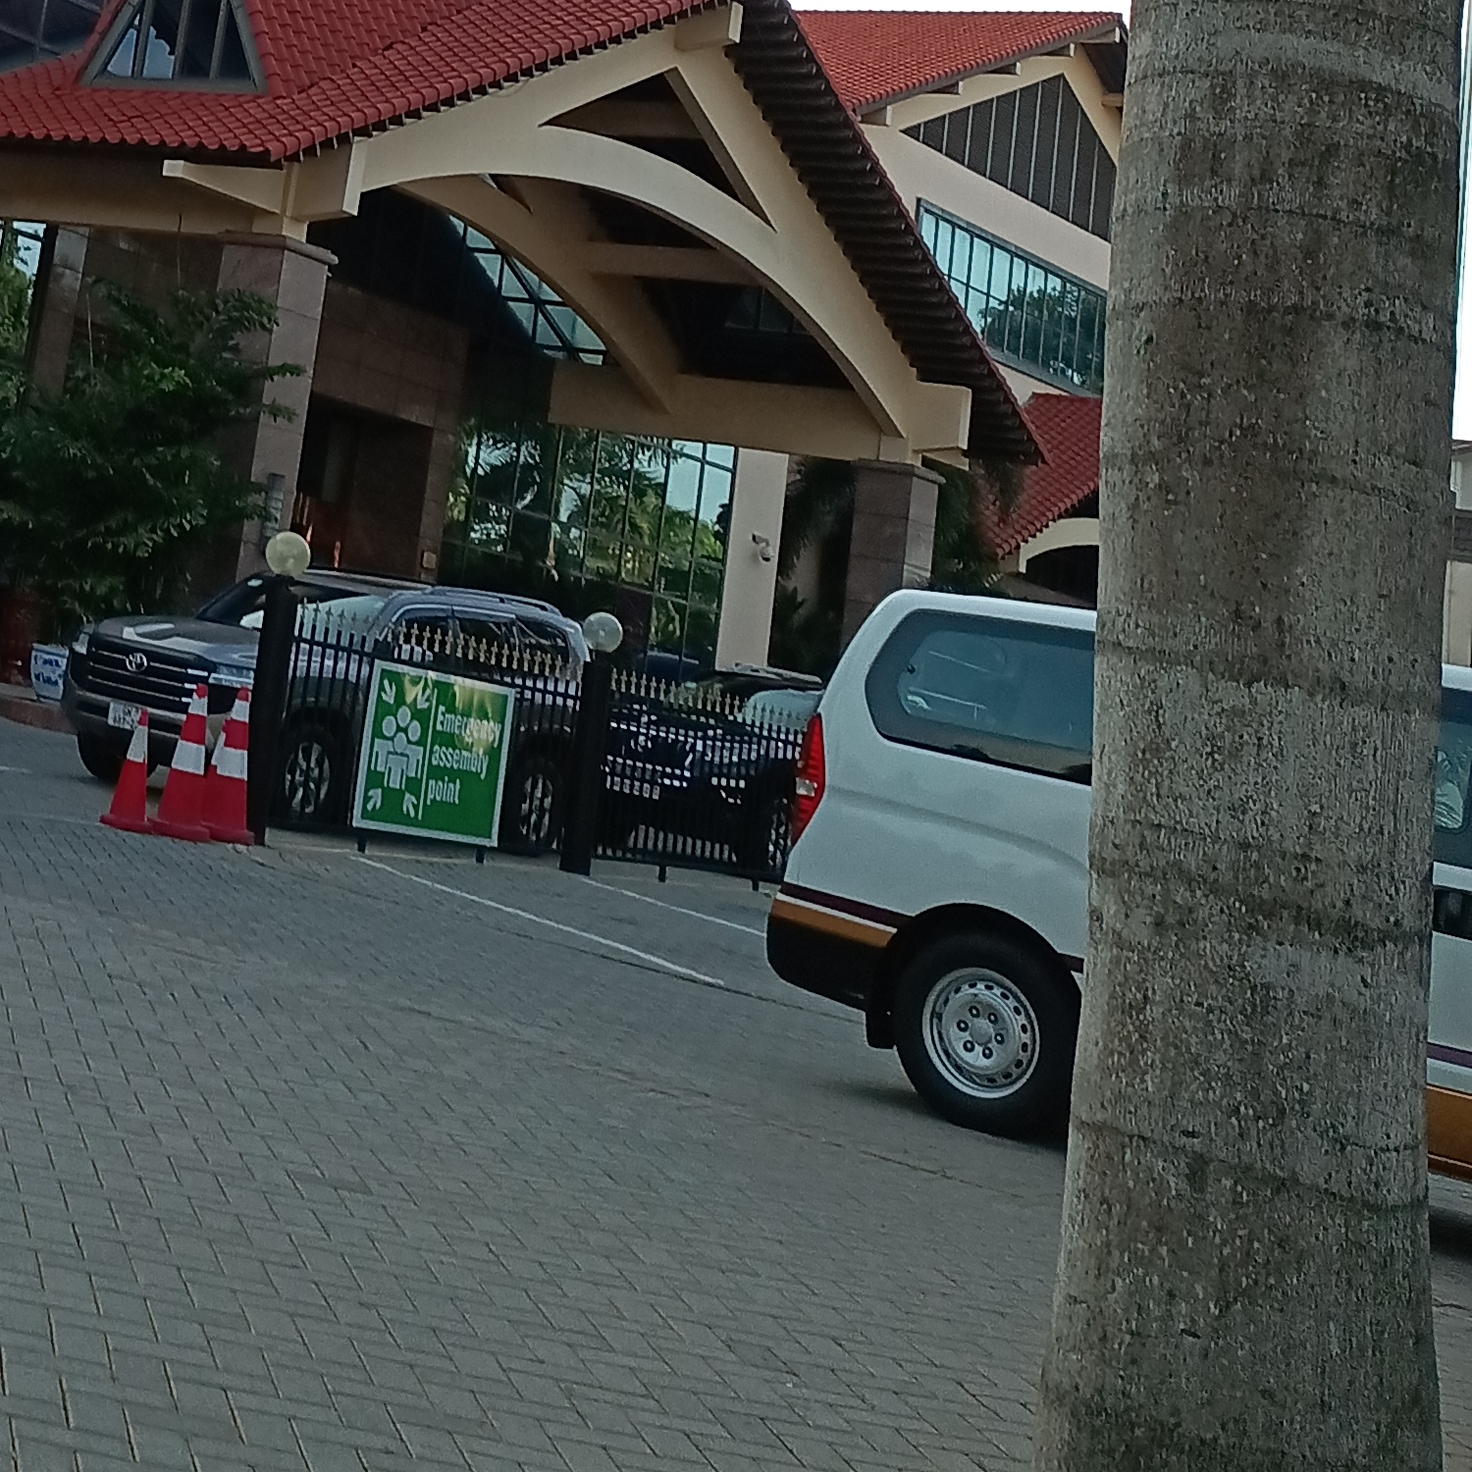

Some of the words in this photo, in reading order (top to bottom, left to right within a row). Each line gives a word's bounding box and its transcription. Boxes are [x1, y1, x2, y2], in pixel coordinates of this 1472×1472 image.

[436, 705, 501, 748] Emergency
[432, 744, 488, 780] assembly
[427, 776, 460, 805] point
